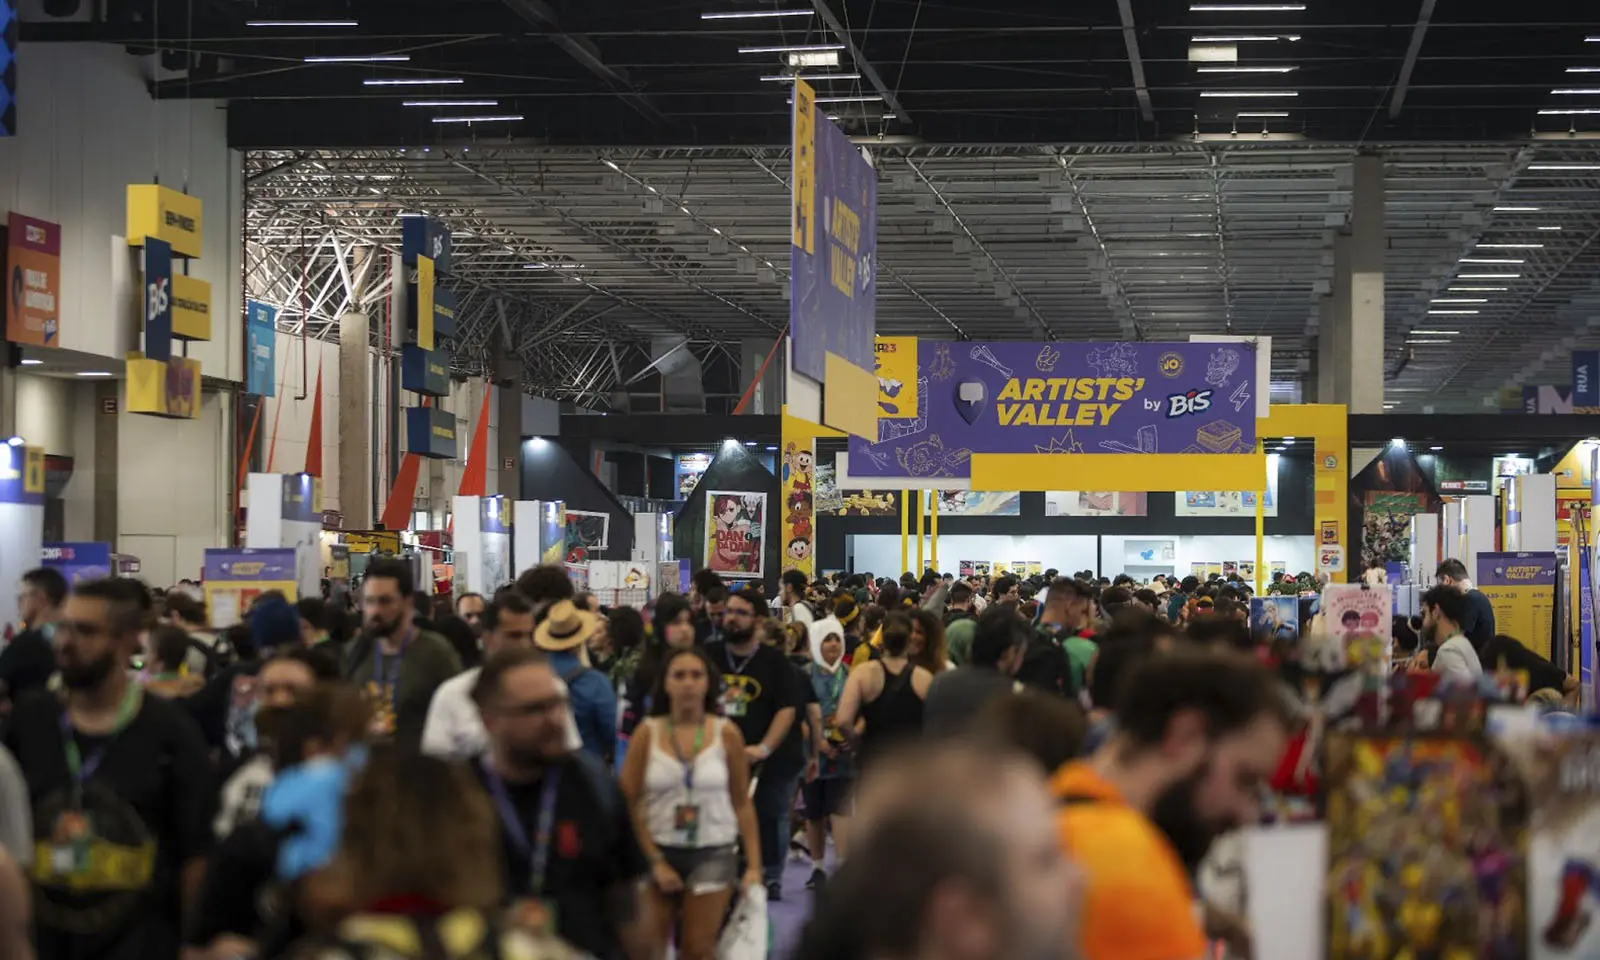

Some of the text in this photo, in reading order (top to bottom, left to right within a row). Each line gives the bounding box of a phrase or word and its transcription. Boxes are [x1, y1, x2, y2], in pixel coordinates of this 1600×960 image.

[996, 377, 1145, 401] ARTISTS'
[1576, 364, 1588, 393] RUA
[996, 402, 1121, 426] VALLEY
[1143, 398, 1161, 412] by
[716, 530, 744, 541] DAN
